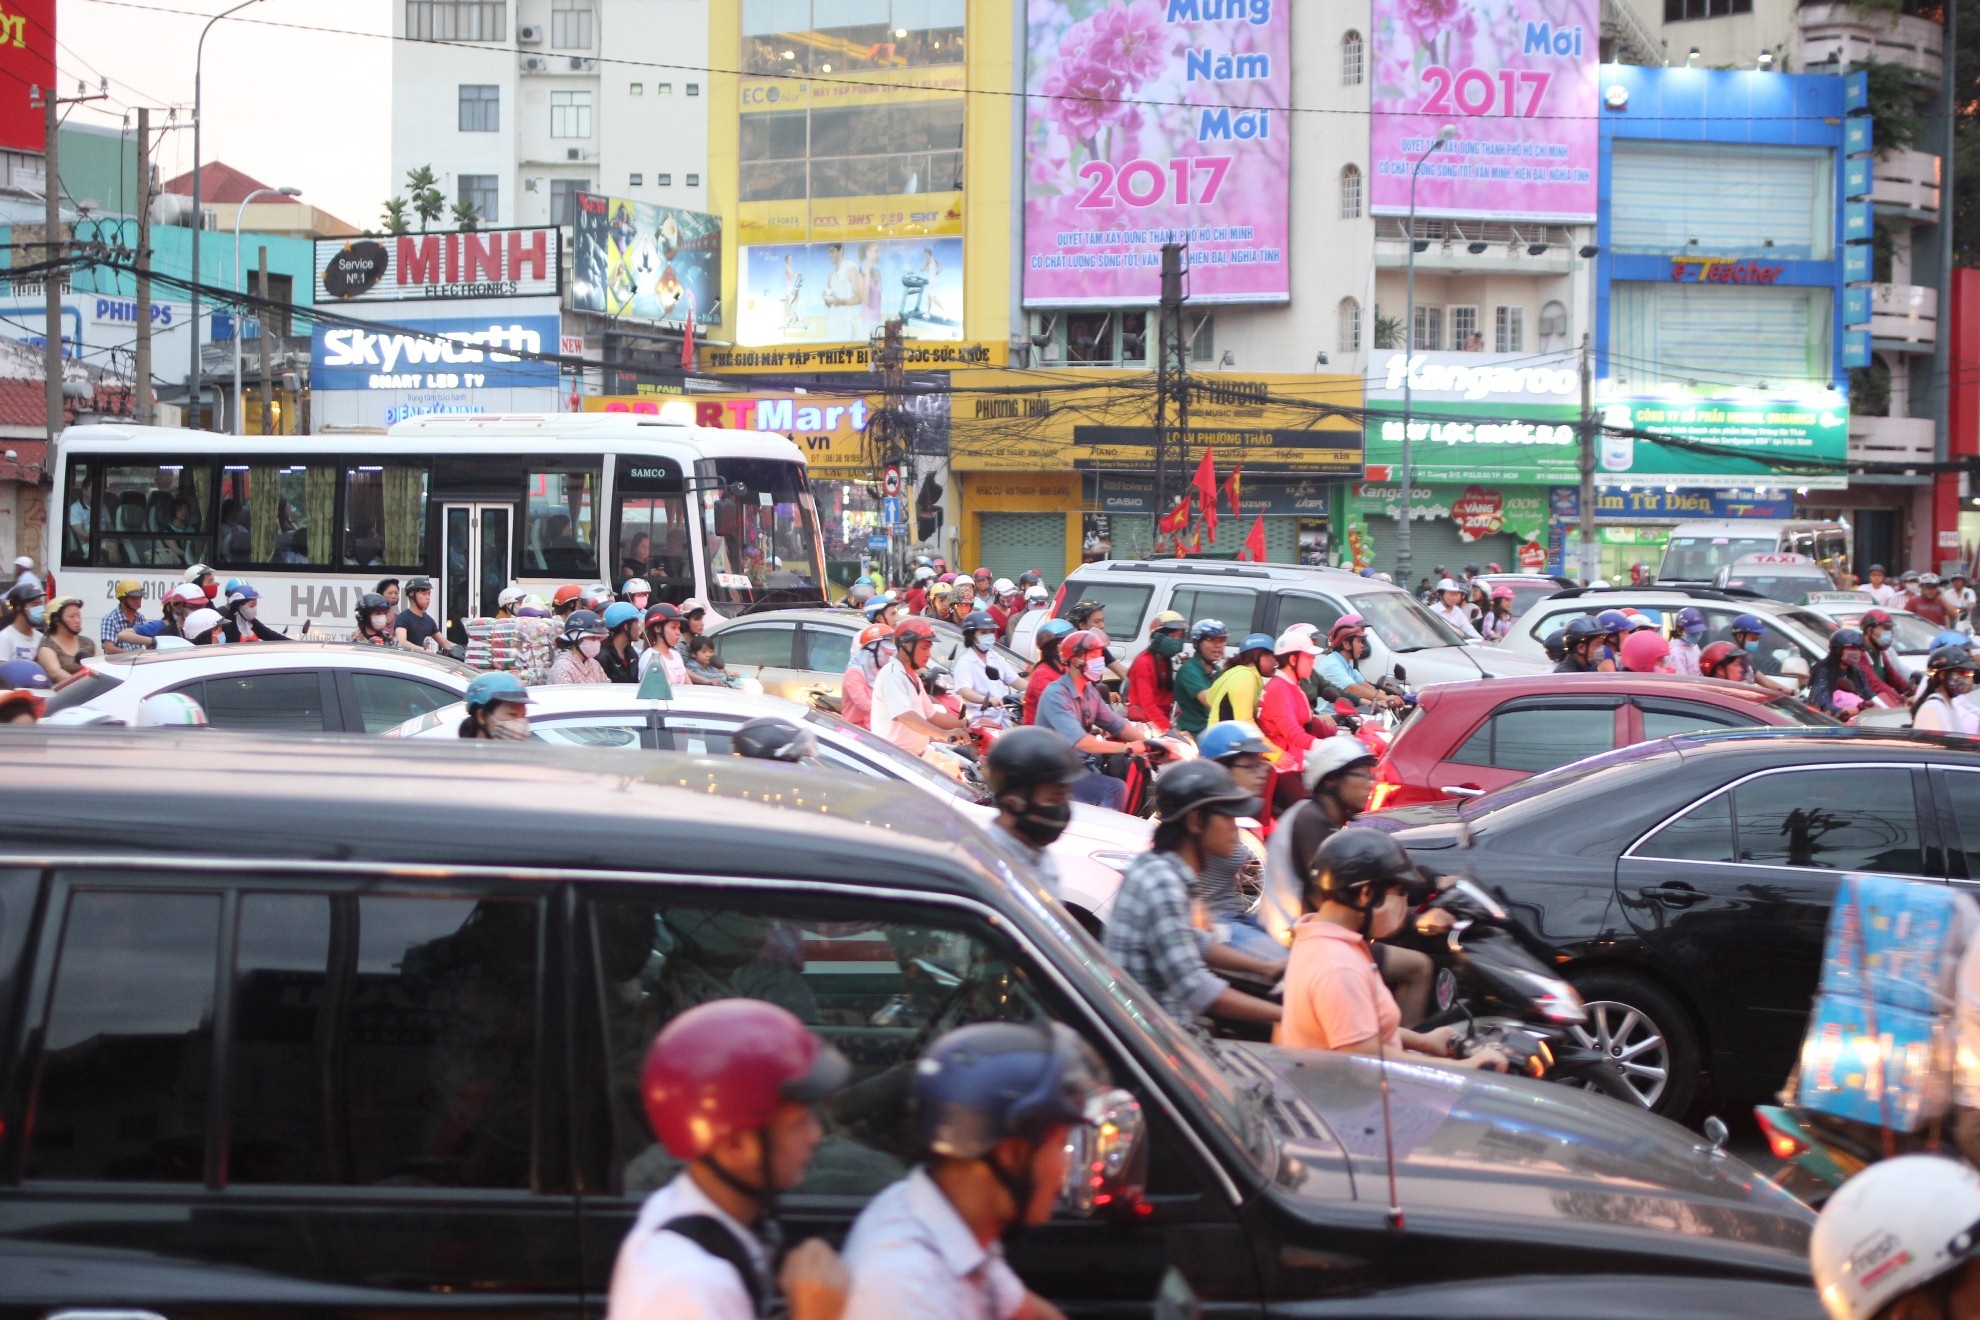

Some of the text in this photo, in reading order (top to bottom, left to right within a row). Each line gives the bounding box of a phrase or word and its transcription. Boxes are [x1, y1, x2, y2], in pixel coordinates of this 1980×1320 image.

[1524, 22, 1583, 56] Mới
[1187, 48, 1269, 81] Năm
[1420, 65, 1552, 118] 2017
[1199, 108, 1269, 141] Mới
[1077, 157, 1234, 209] 2017
[1230, 226, 1253, 240] MINH
[338, 258, 374, 270] Service
[396, 230, 547, 285] MINH
[425, 281, 518, 297] ELECTRONICS
[96, 299, 173, 325] PHILPS
[323, 324, 541, 373] Skyworth
[561, 337, 583, 354] NEW
[932, 345, 956, 362] SỨC
[710, 348, 733, 366] THẾ
[735, 349, 760, 366] GIỚI
[761, 348, 785, 366] MÁY
[786, 348, 811, 369] TẬP
[817, 347, 854, 365] THIẾT
[368, 373, 486, 390] SMART LED TV
[1385, 353, 1578, 400] Kangaroo
[1205, 410, 1232, 418] MUSIC
[1637, 408, 1666, 422] CÔNG
[1667, 409, 1680, 422] TY
[1197, 429, 1273, 445] PHƯƠNG THẢO
[1091, 448, 1118, 457] PIANO
[631, 468, 665, 478] SAMCO
[1118, 481, 1153, 491] Roland
[1352, 483, 1433, 501] Kangaoo
[1106, 497, 1143, 506] CASIO
[1464, 502, 1494, 513] VÀNG
[1507, 498, 1541, 509] 100%
[1630, 493, 1661, 510] Từ
[1665, 491, 1712, 511] Điển
[1466, 516, 1491, 527] 2017
[1754, 555, 1797, 563] TAXI
[290, 584, 348, 618] HAI
